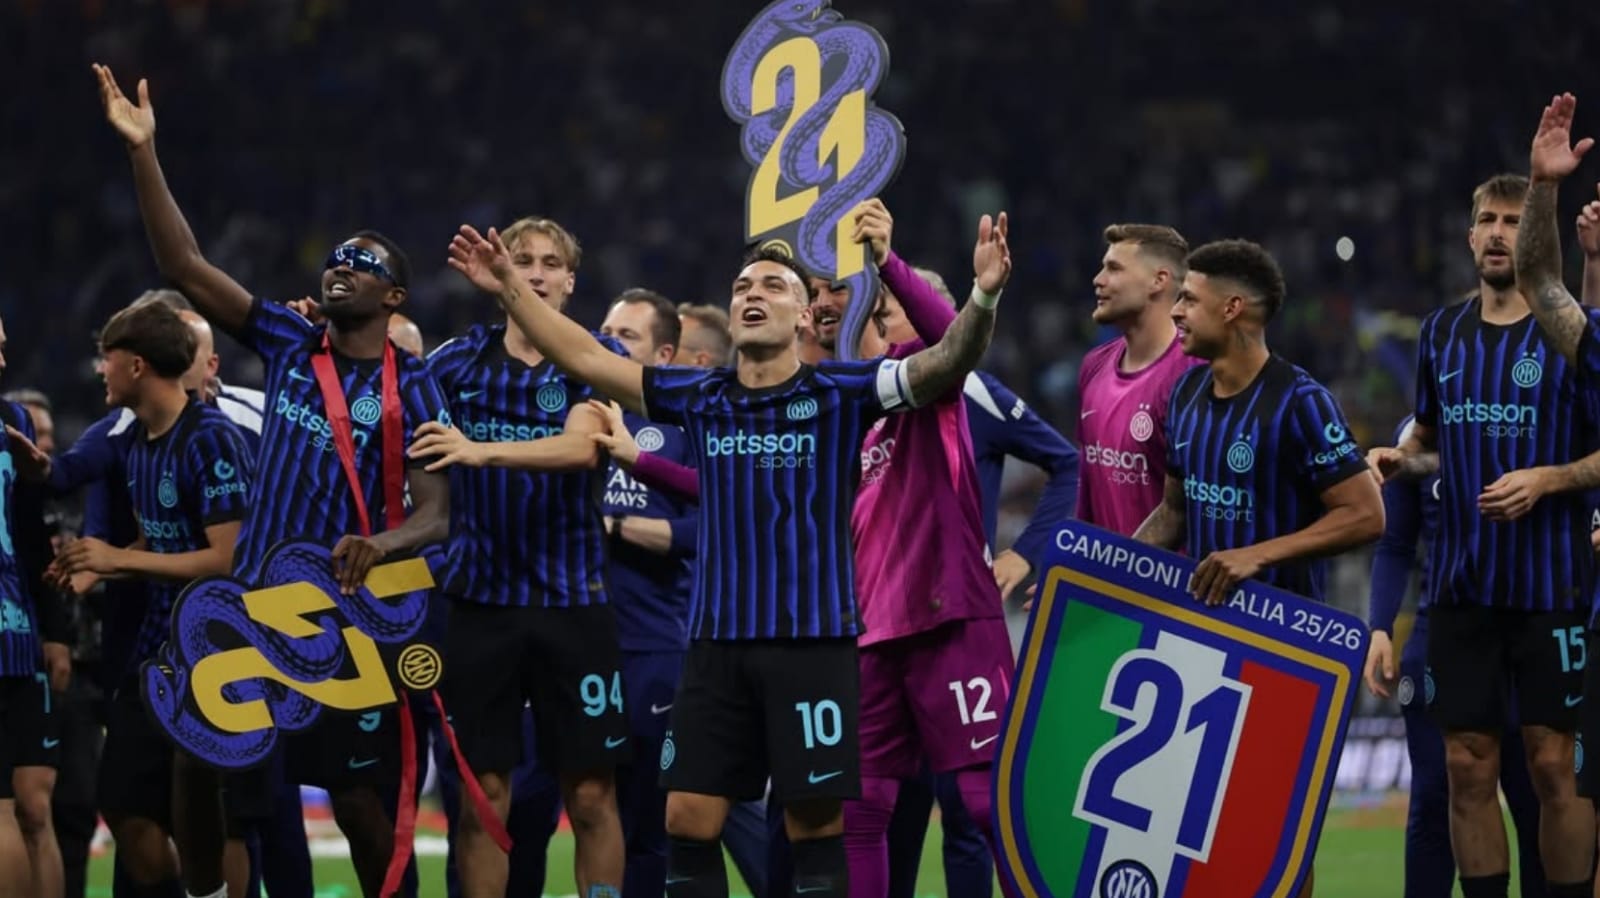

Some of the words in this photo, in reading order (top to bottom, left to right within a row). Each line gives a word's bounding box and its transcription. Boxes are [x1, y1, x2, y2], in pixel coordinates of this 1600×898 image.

[750, 36, 865, 280] 21
[276, 390, 368, 447] betssn
[1441, 396, 1536, 425] betsson
[706, 429, 815, 457] betsson
[755, 453, 815, 471] .sport
[1085, 439, 1148, 471] etsson
[604, 490, 648, 509] WAYS
[1202, 505, 1252, 523] .sport
[1055, 528, 1181, 588] CAMPIONI
[1290, 609, 1362, 650] 25/26
[1552, 626, 1586, 673] 15
[580, 670, 624, 717] 94
[948, 676, 997, 725] 12
[795, 699, 842, 750] 10
[1083, 657, 1243, 853] 21
